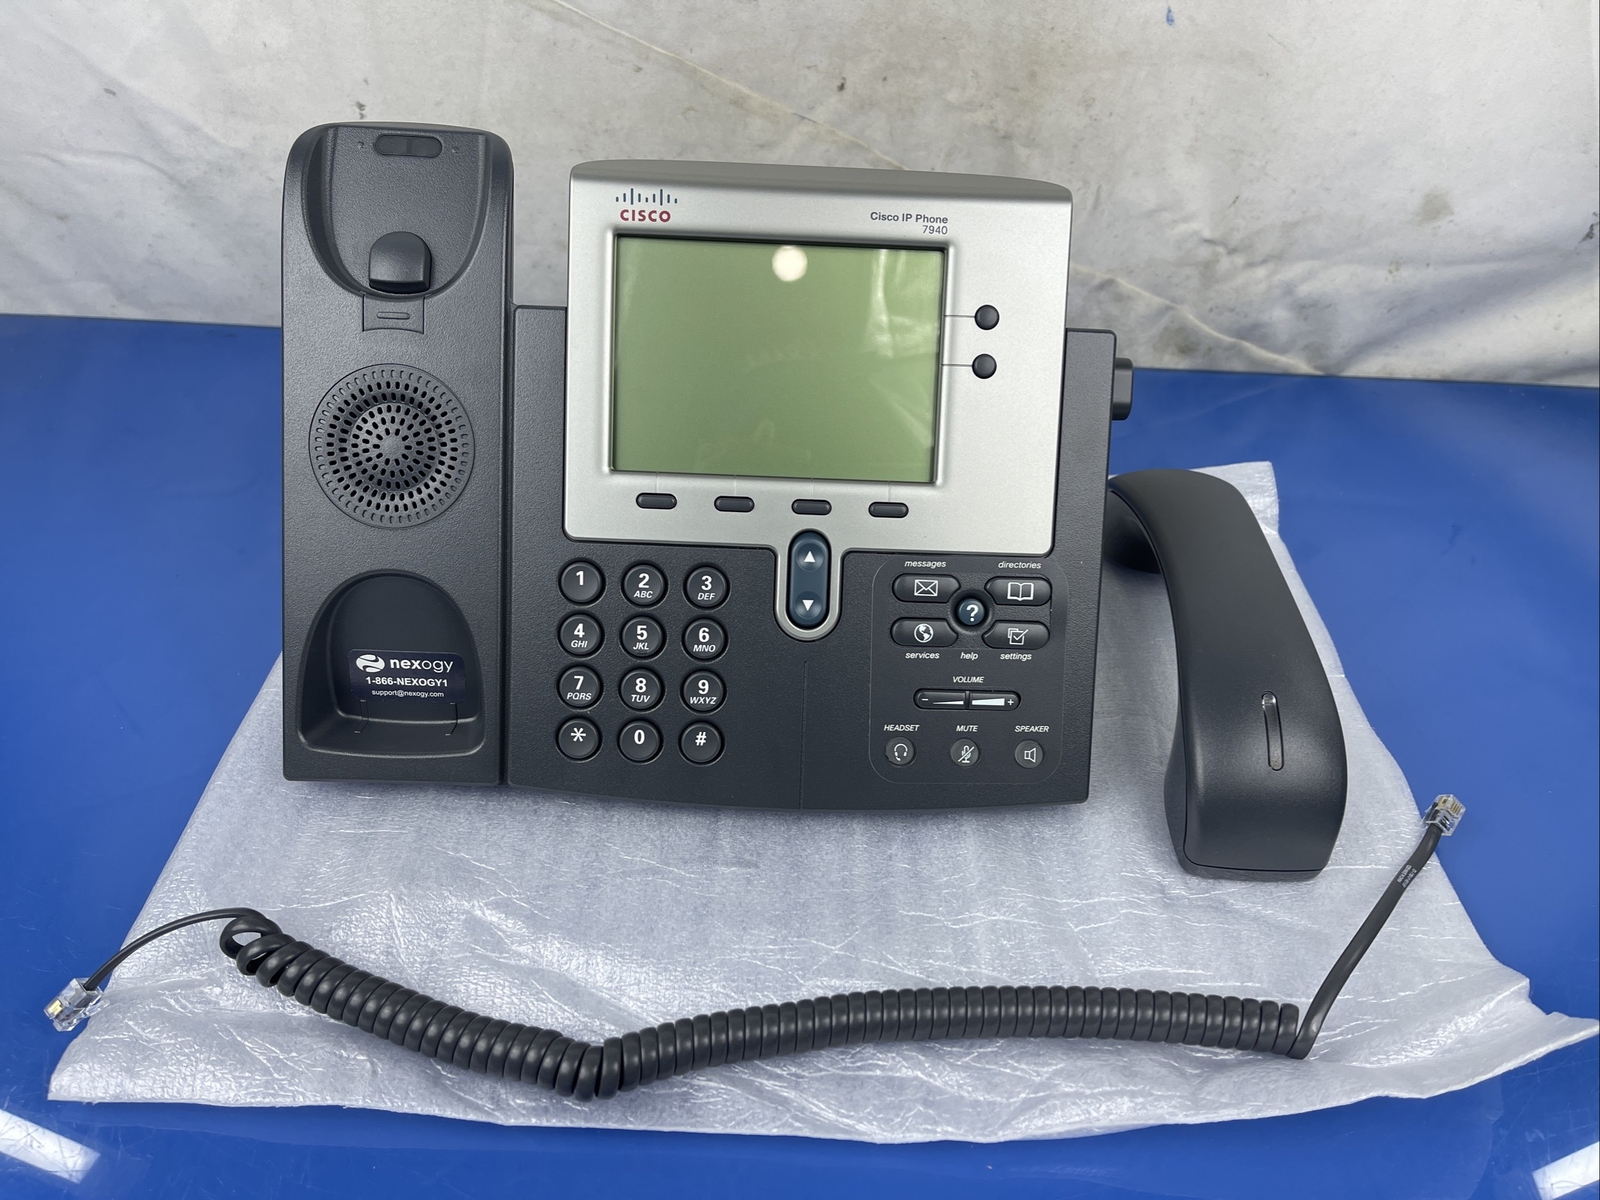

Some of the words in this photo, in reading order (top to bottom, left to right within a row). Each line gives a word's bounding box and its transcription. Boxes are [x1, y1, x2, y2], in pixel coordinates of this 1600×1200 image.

[620, 209, 671, 223] CISCO
[870, 212, 900, 222] Cisco
[902, 213, 912, 222] IP
[915, 214, 948, 224] Phone
[922, 225, 948, 235] 7940
[998, 561, 1041, 569] directories
[576, 571, 584, 586] 1
[638, 573, 650, 588] 2
[701, 576, 712, 590] 3
[634, 591, 653, 599] ABC
[573, 624, 585, 638] 4
[636, 626, 647, 640] 5
[698, 628, 710, 642] 6
[571, 640, 588, 648] GHI
[905, 651, 940, 659] services
[960, 652, 978, 660] help
[1000, 652, 1032, 661] settings
[390, 659, 453, 673] nexogy
[366, 677, 448, 687] 1-866-NEXOGY1
[574, 676, 584, 690] 7
[635, 678, 647, 692] 8
[698, 680, 709, 694] 9
[372, 690, 444, 698] support@nexogy.com
[567, 692, 592, 700] PQRS
[634, 729, 645, 744] 0
[695, 732, 707, 746] #
